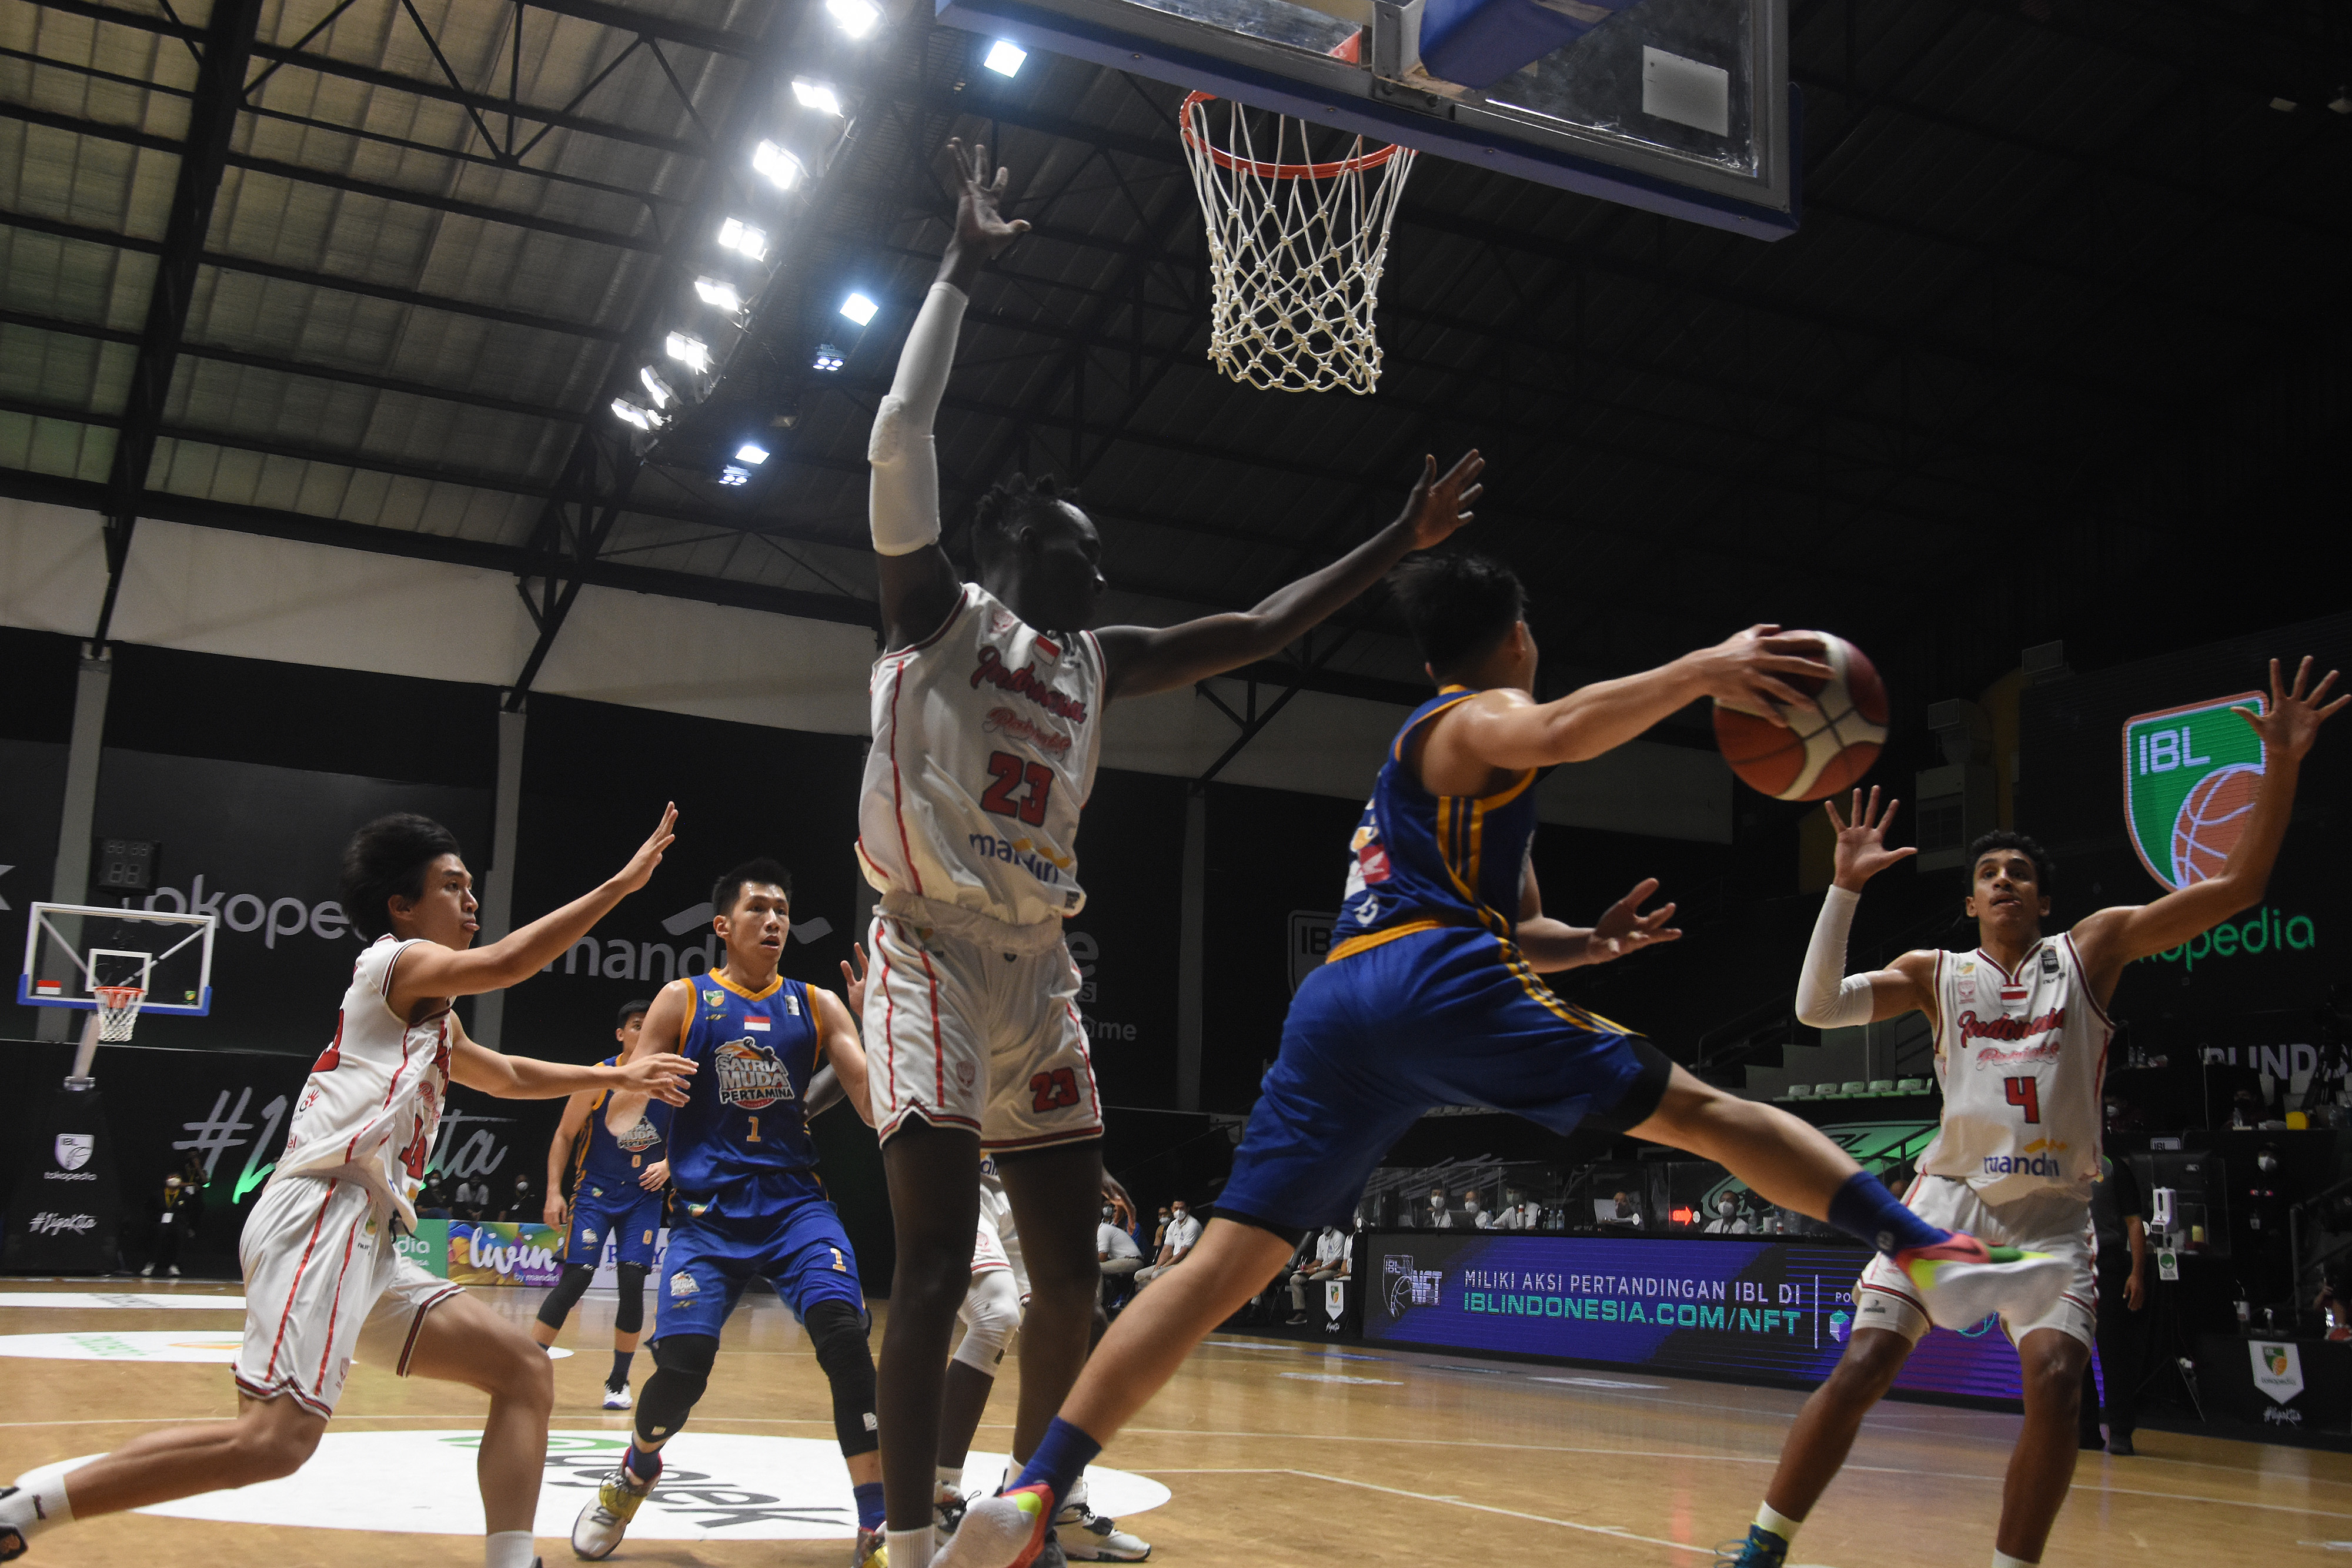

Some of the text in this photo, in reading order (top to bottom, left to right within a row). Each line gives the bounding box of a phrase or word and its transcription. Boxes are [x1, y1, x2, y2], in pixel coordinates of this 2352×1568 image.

[2139, 727, 2211, 775] IBL
[980, 750, 1055, 827] 23
[1302, 925, 1332, 955] IB
[717, 1056, 787, 1075] SATRIA
[721, 1071, 789, 1090] MUDA
[721, 1088, 794, 1102] PERTAMINA
[1030, 1067, 1080, 1113] 23
[2004, 1076, 2040, 1124] 4
[746, 1116, 761, 1142] 1
[830, 1248, 846, 1272] 1
[1412, 1270, 1442, 1304] NFT
[1465, 1269, 1800, 1305] MILIKI AKSI PERTANDINGAN IBL DI
[1464, 1292, 1801, 1335] IBLINDONESIA.COM/NFT
